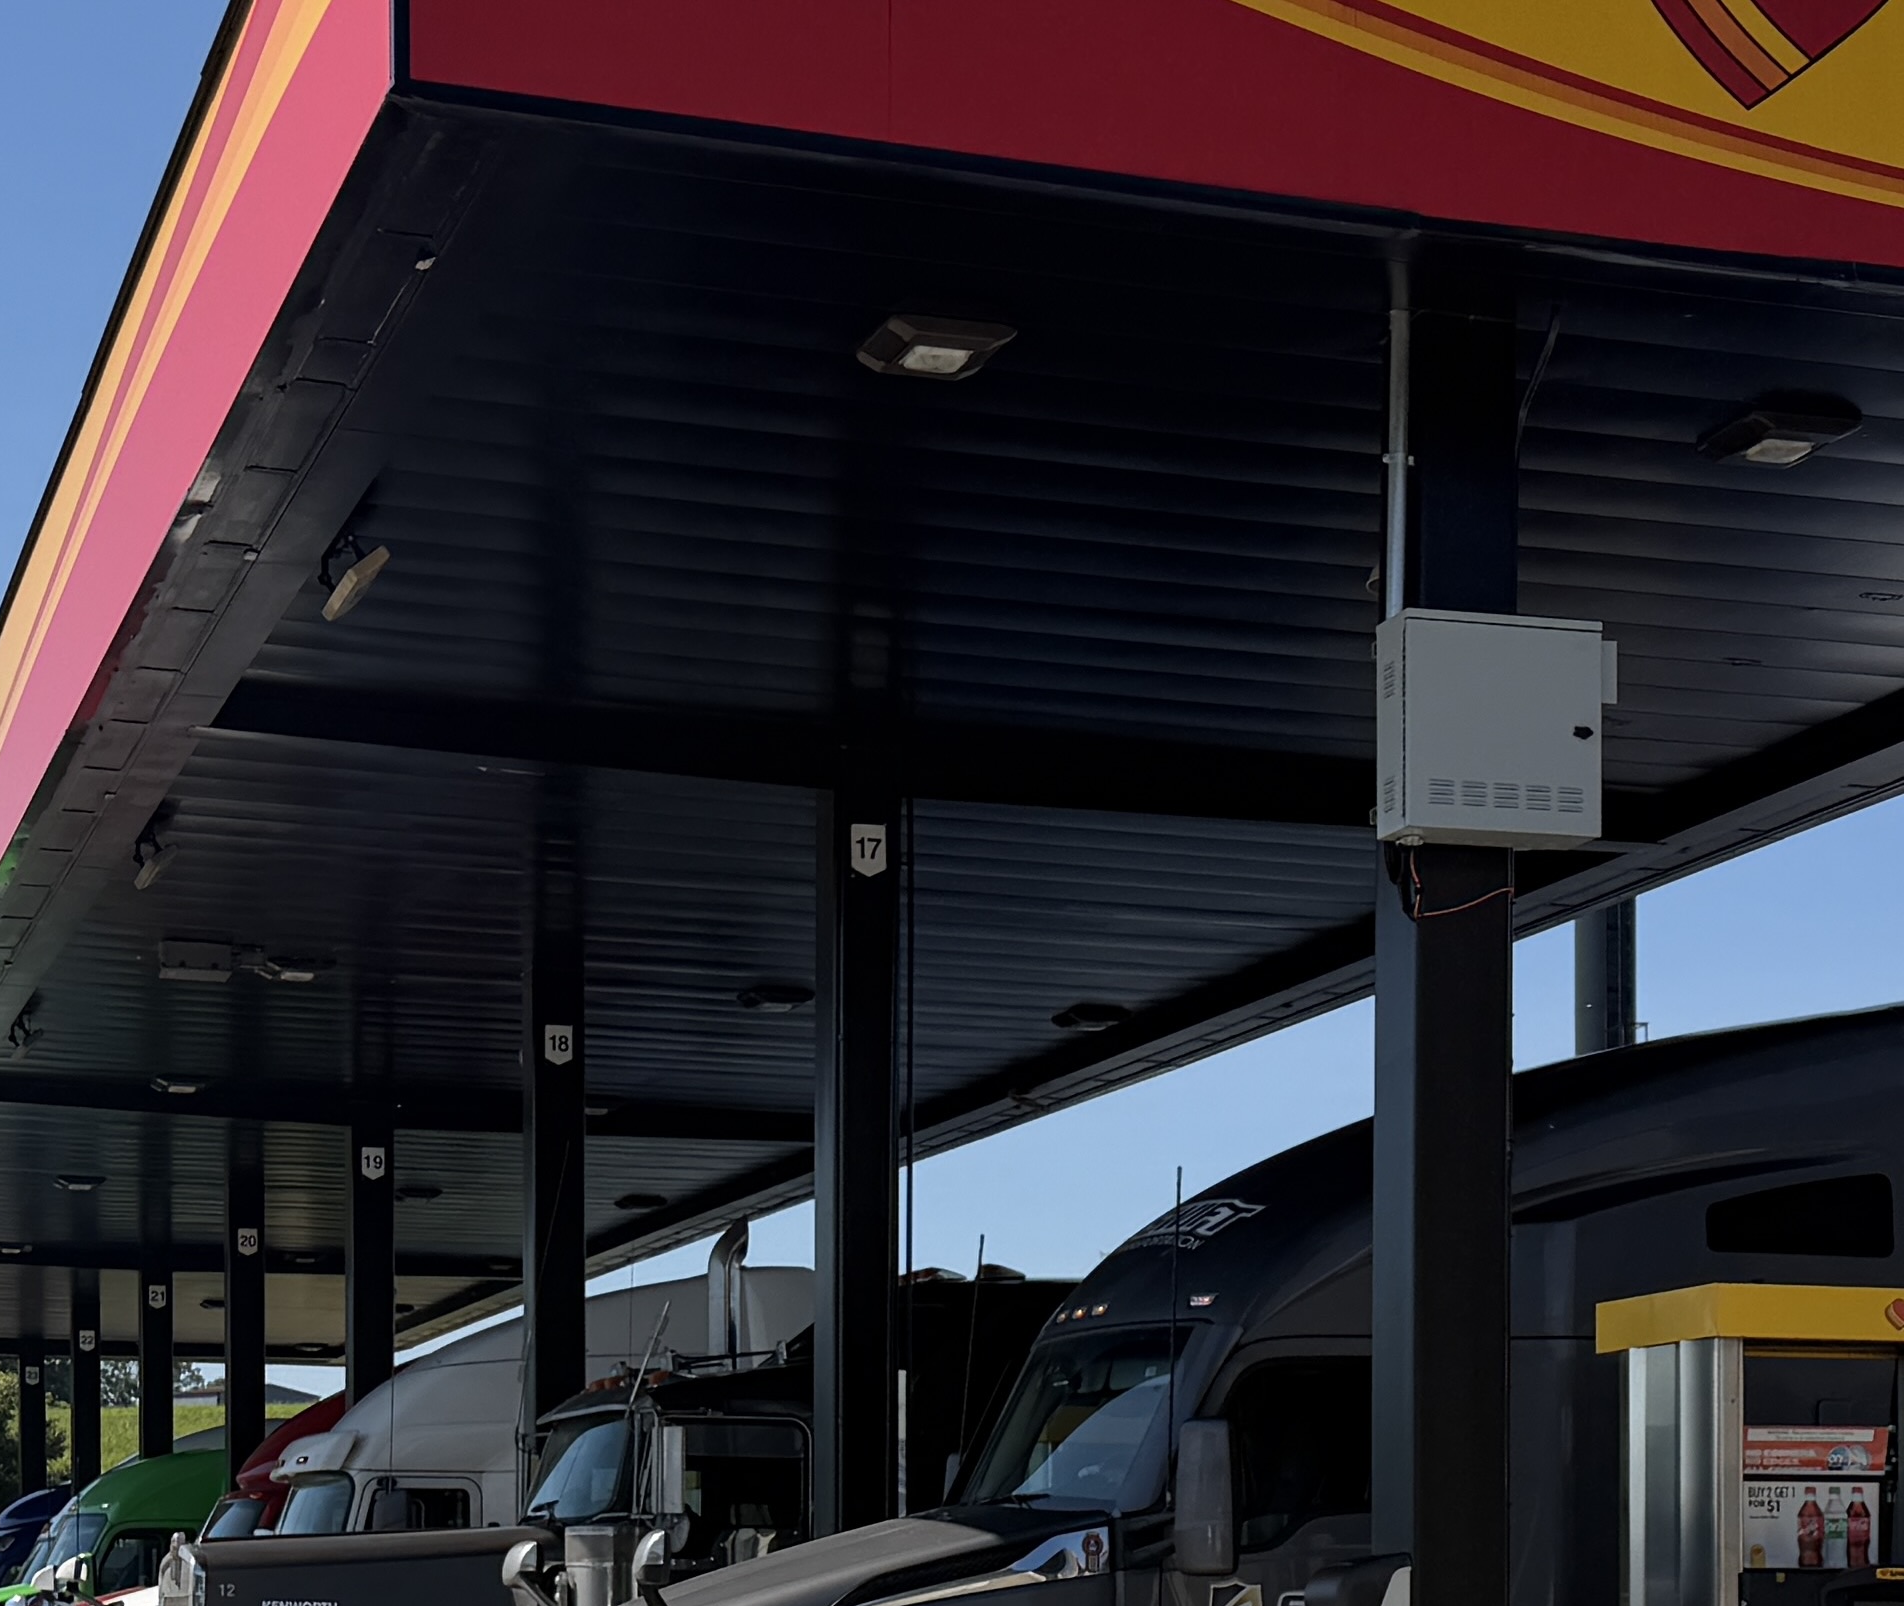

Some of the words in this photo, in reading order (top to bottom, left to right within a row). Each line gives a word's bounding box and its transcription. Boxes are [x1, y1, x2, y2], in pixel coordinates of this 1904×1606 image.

[855, 836, 882, 860] 17
[549, 1034, 569, 1052] 18
[364, 1154, 383, 1169] 19
[240, 1234, 257, 1247] 20
[150, 1290, 165, 1302] 21
[1748, 1486, 1765, 1498] BUY
[1766, 1486, 1771, 1498] 2
[1774, 1486, 1790, 1498] GET
[1766, 1500, 1781, 1512] $1
[219, 1583, 235, 1597] 12
